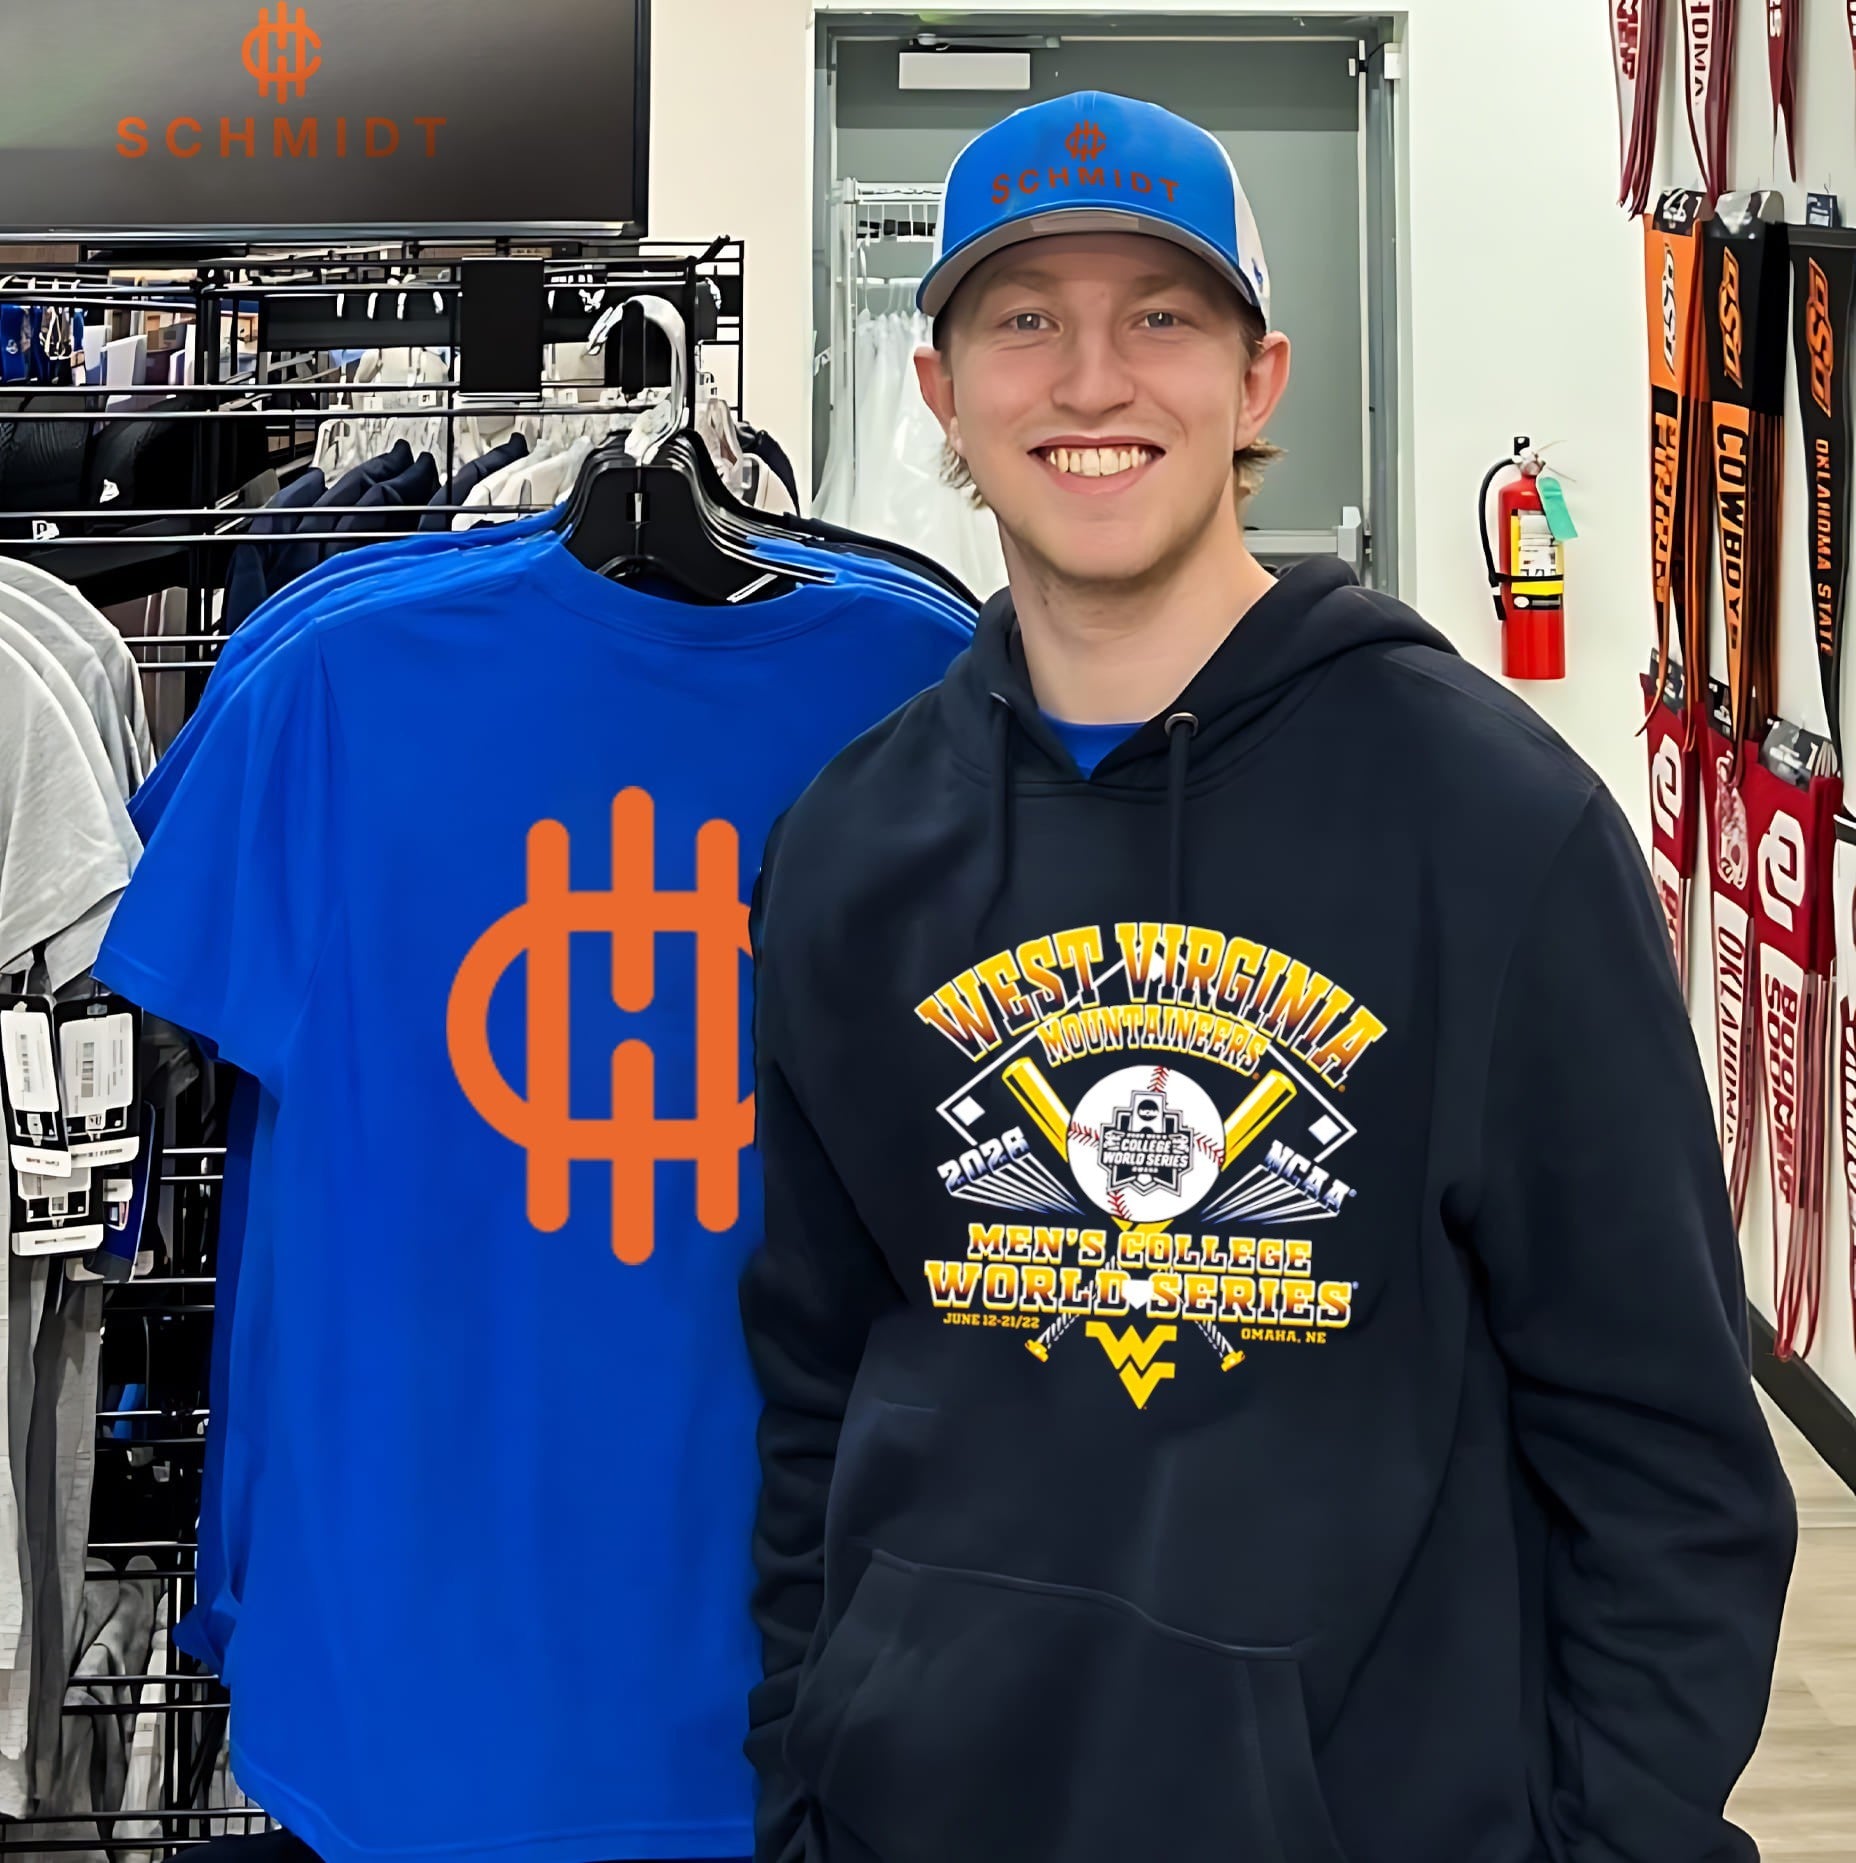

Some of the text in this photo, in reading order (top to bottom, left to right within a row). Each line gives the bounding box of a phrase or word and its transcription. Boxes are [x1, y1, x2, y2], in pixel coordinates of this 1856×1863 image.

[116, 116, 448, 158] SCHMIDT
[992, 167, 1179, 205] SCHMIDT
[1717, 423, 1749, 649] COWBOY
[914, 922, 1388, 1089] WEST VIRGINIA
[1035, 1004, 1271, 1077] MOUNTAINEERS
[1102, 1151, 1190, 1168] WORLD SERIES
[1121, 1138, 1172, 1154] COLLEGE
[1264, 1139, 1350, 1215] NCAA
[967, 1223, 1312, 1278] MEN'S COLLEGE
[924, 1260, 1352, 1329] WORLD SERIES
[943, 1312, 980, 1326] JUNE
[1305, 1331, 1327, 1344] NE
